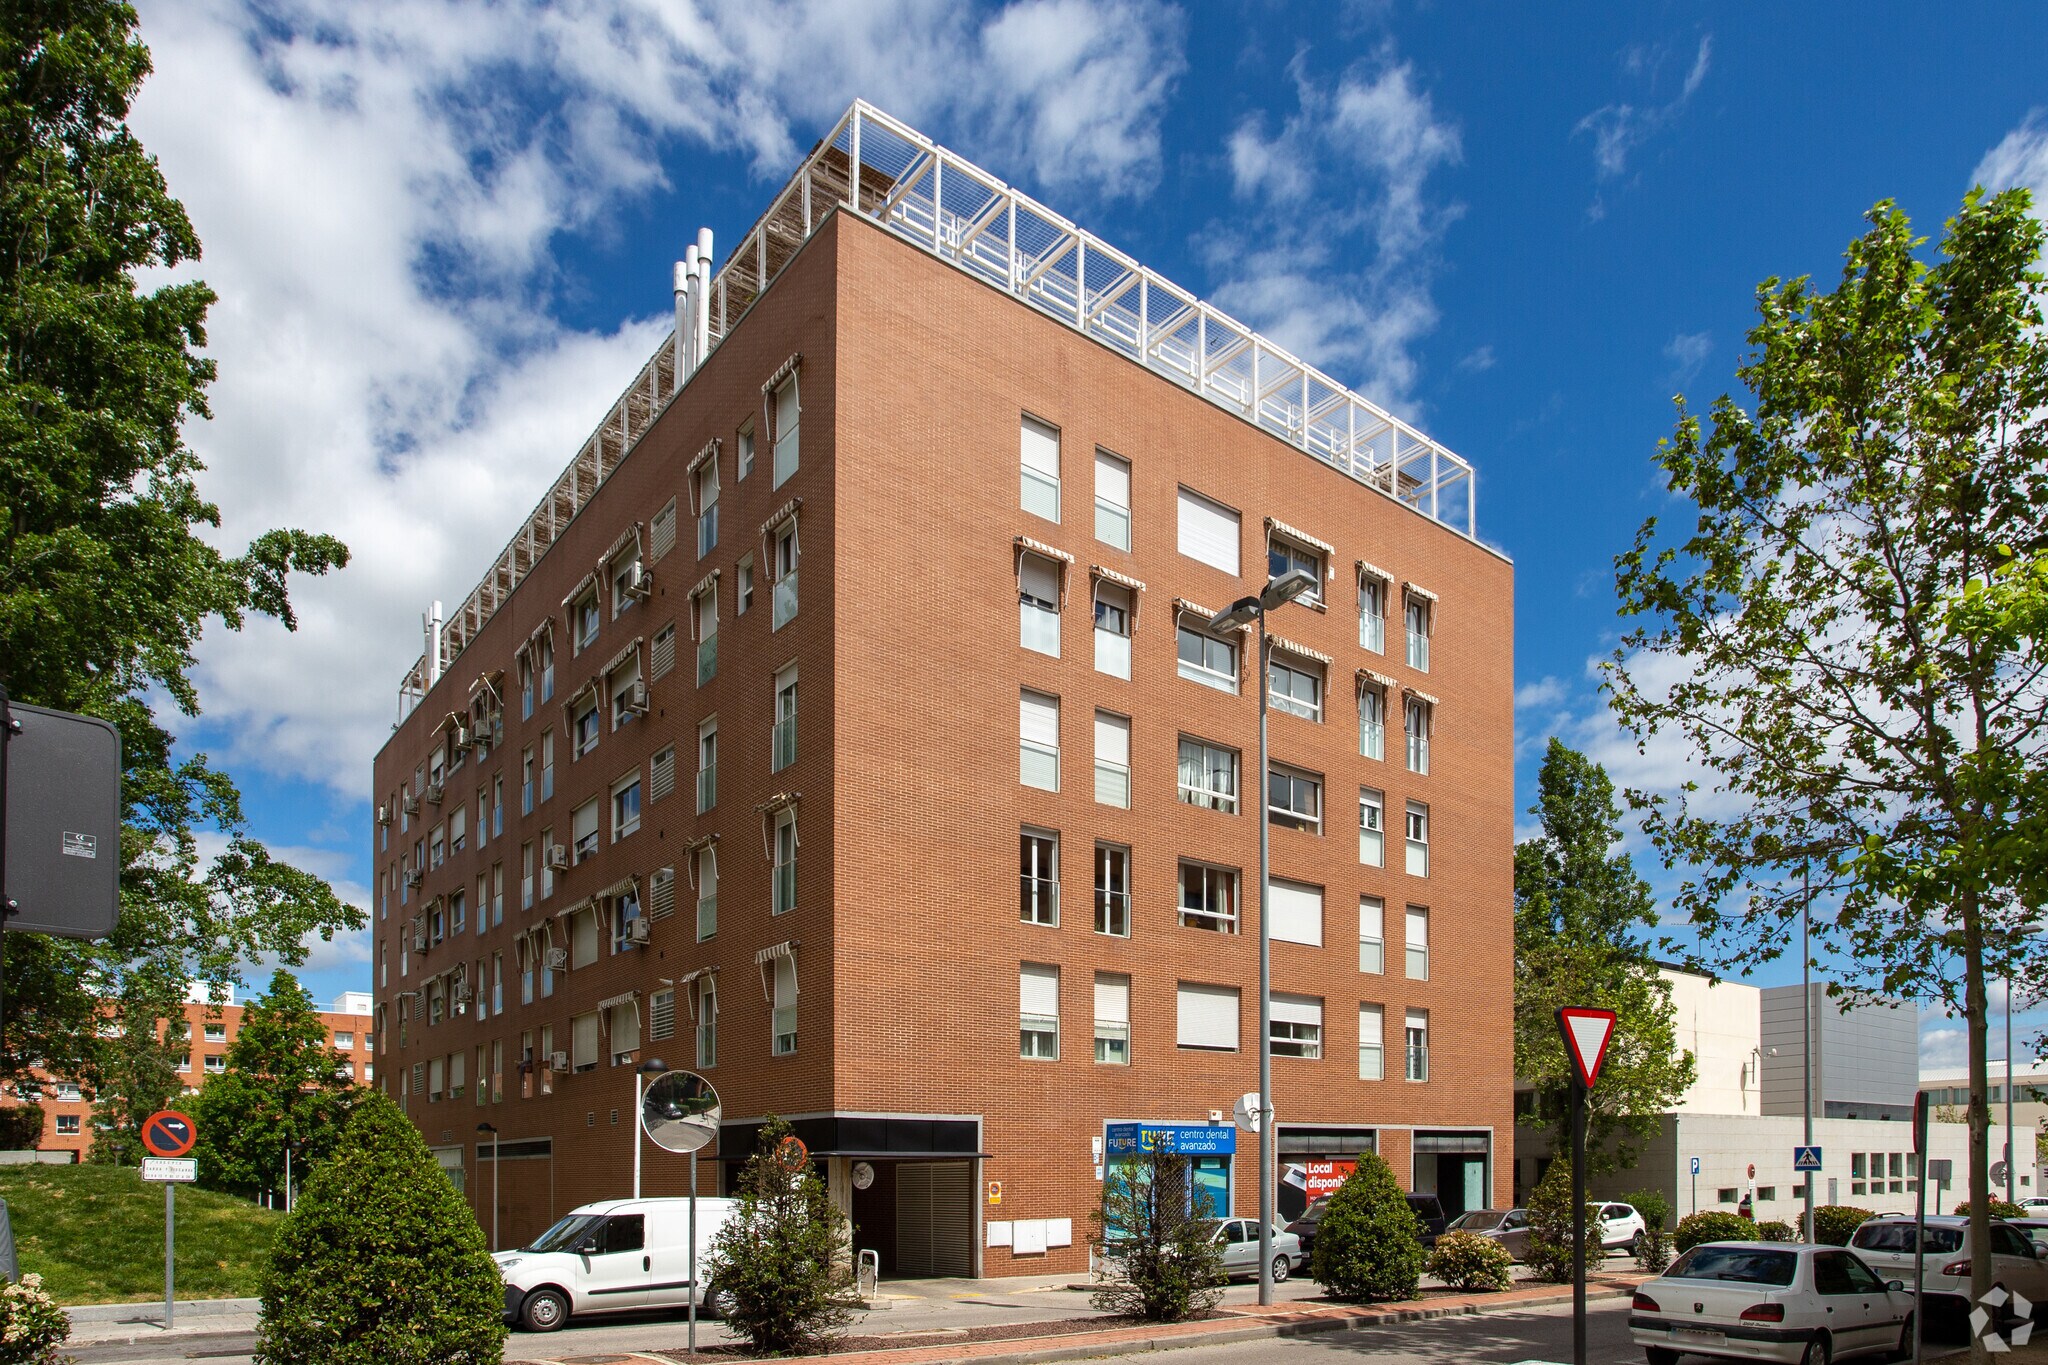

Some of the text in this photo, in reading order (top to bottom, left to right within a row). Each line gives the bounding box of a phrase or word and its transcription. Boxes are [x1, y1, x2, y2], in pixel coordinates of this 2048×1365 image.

[1180, 1128, 1230, 1140] centro dental
[1108, 1138, 1137, 1149] FUTURE
[1180, 1139, 1217, 1151] avanzado
[1308, 1162, 1333, 1174] Local
[1692, 1158, 1698, 1173] P
[1308, 1175, 1349, 1191] disponi
